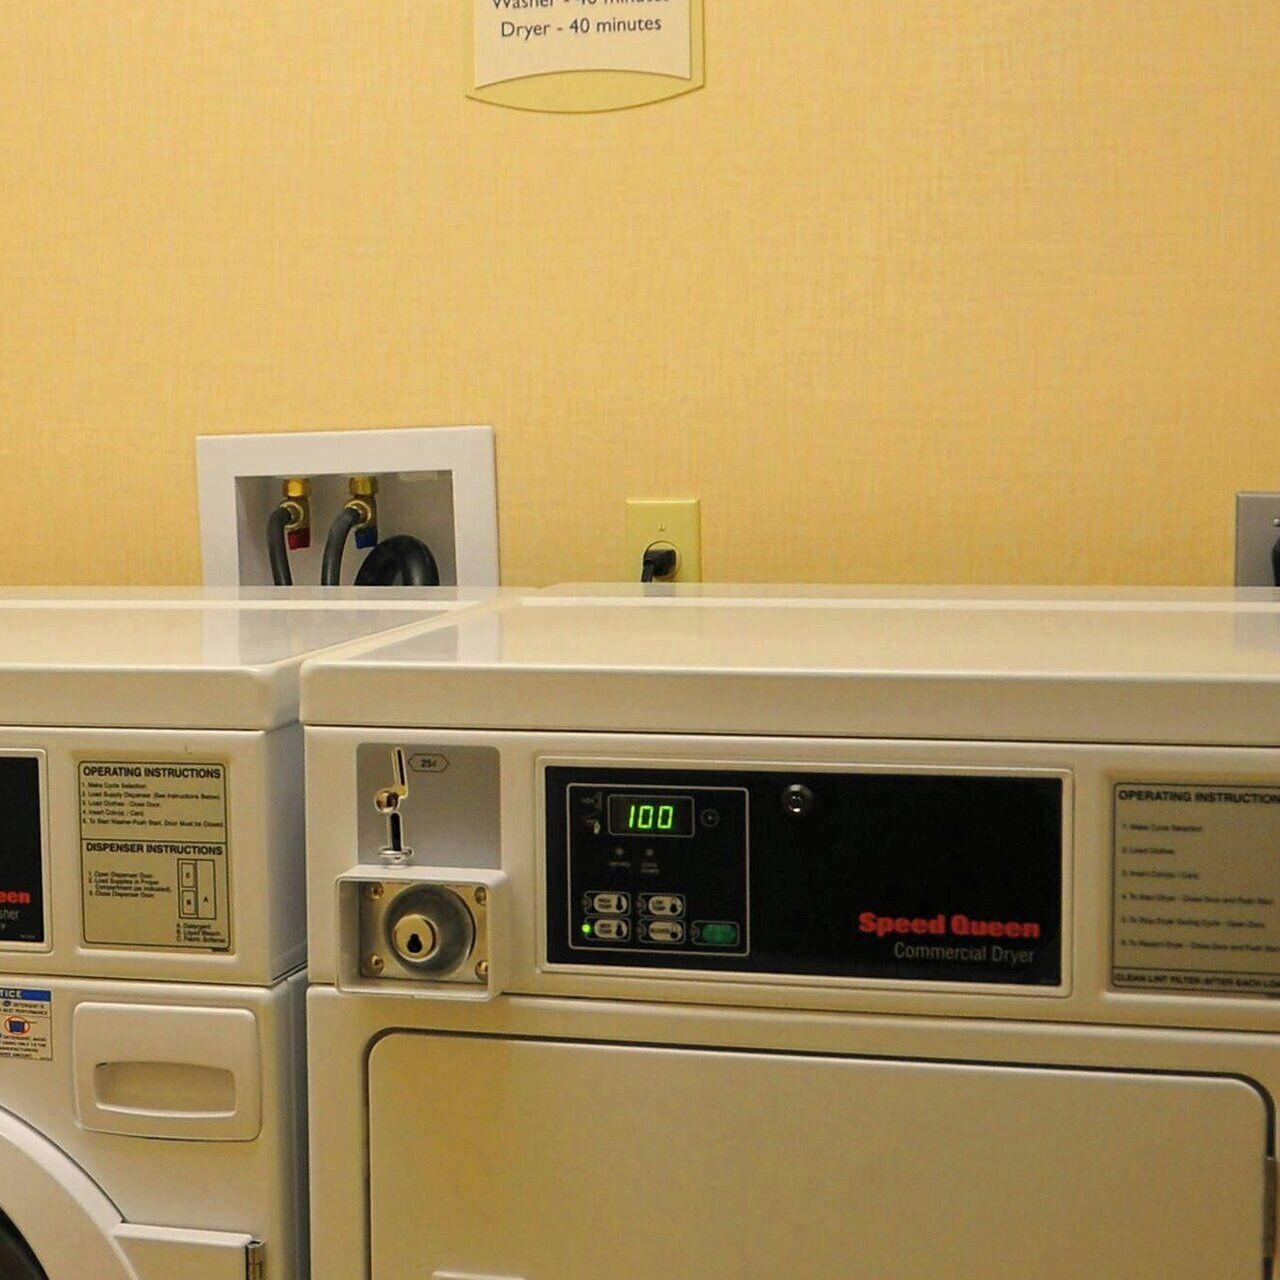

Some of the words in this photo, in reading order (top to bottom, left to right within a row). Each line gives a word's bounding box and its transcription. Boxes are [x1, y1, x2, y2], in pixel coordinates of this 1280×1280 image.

[501, 21, 550, 41] Dryer
[569, 18, 590, 34] 40
[596, 17, 662, 33] minutes
[83, 766, 142, 777] OPERATING
[144, 767, 221, 779] INSTRUCTIONS
[1119, 790, 1192, 802] OPERATING
[628, 805, 674, 829] 100
[86, 842, 144, 853] DISPENSER
[146, 844, 223, 855] INSTRUCTIONS
[859, 911, 946, 937] Speed
[950, 914, 1040, 939] Queen
[894, 941, 986, 961] Commercial
[991, 945, 1035, 966] Dryer
